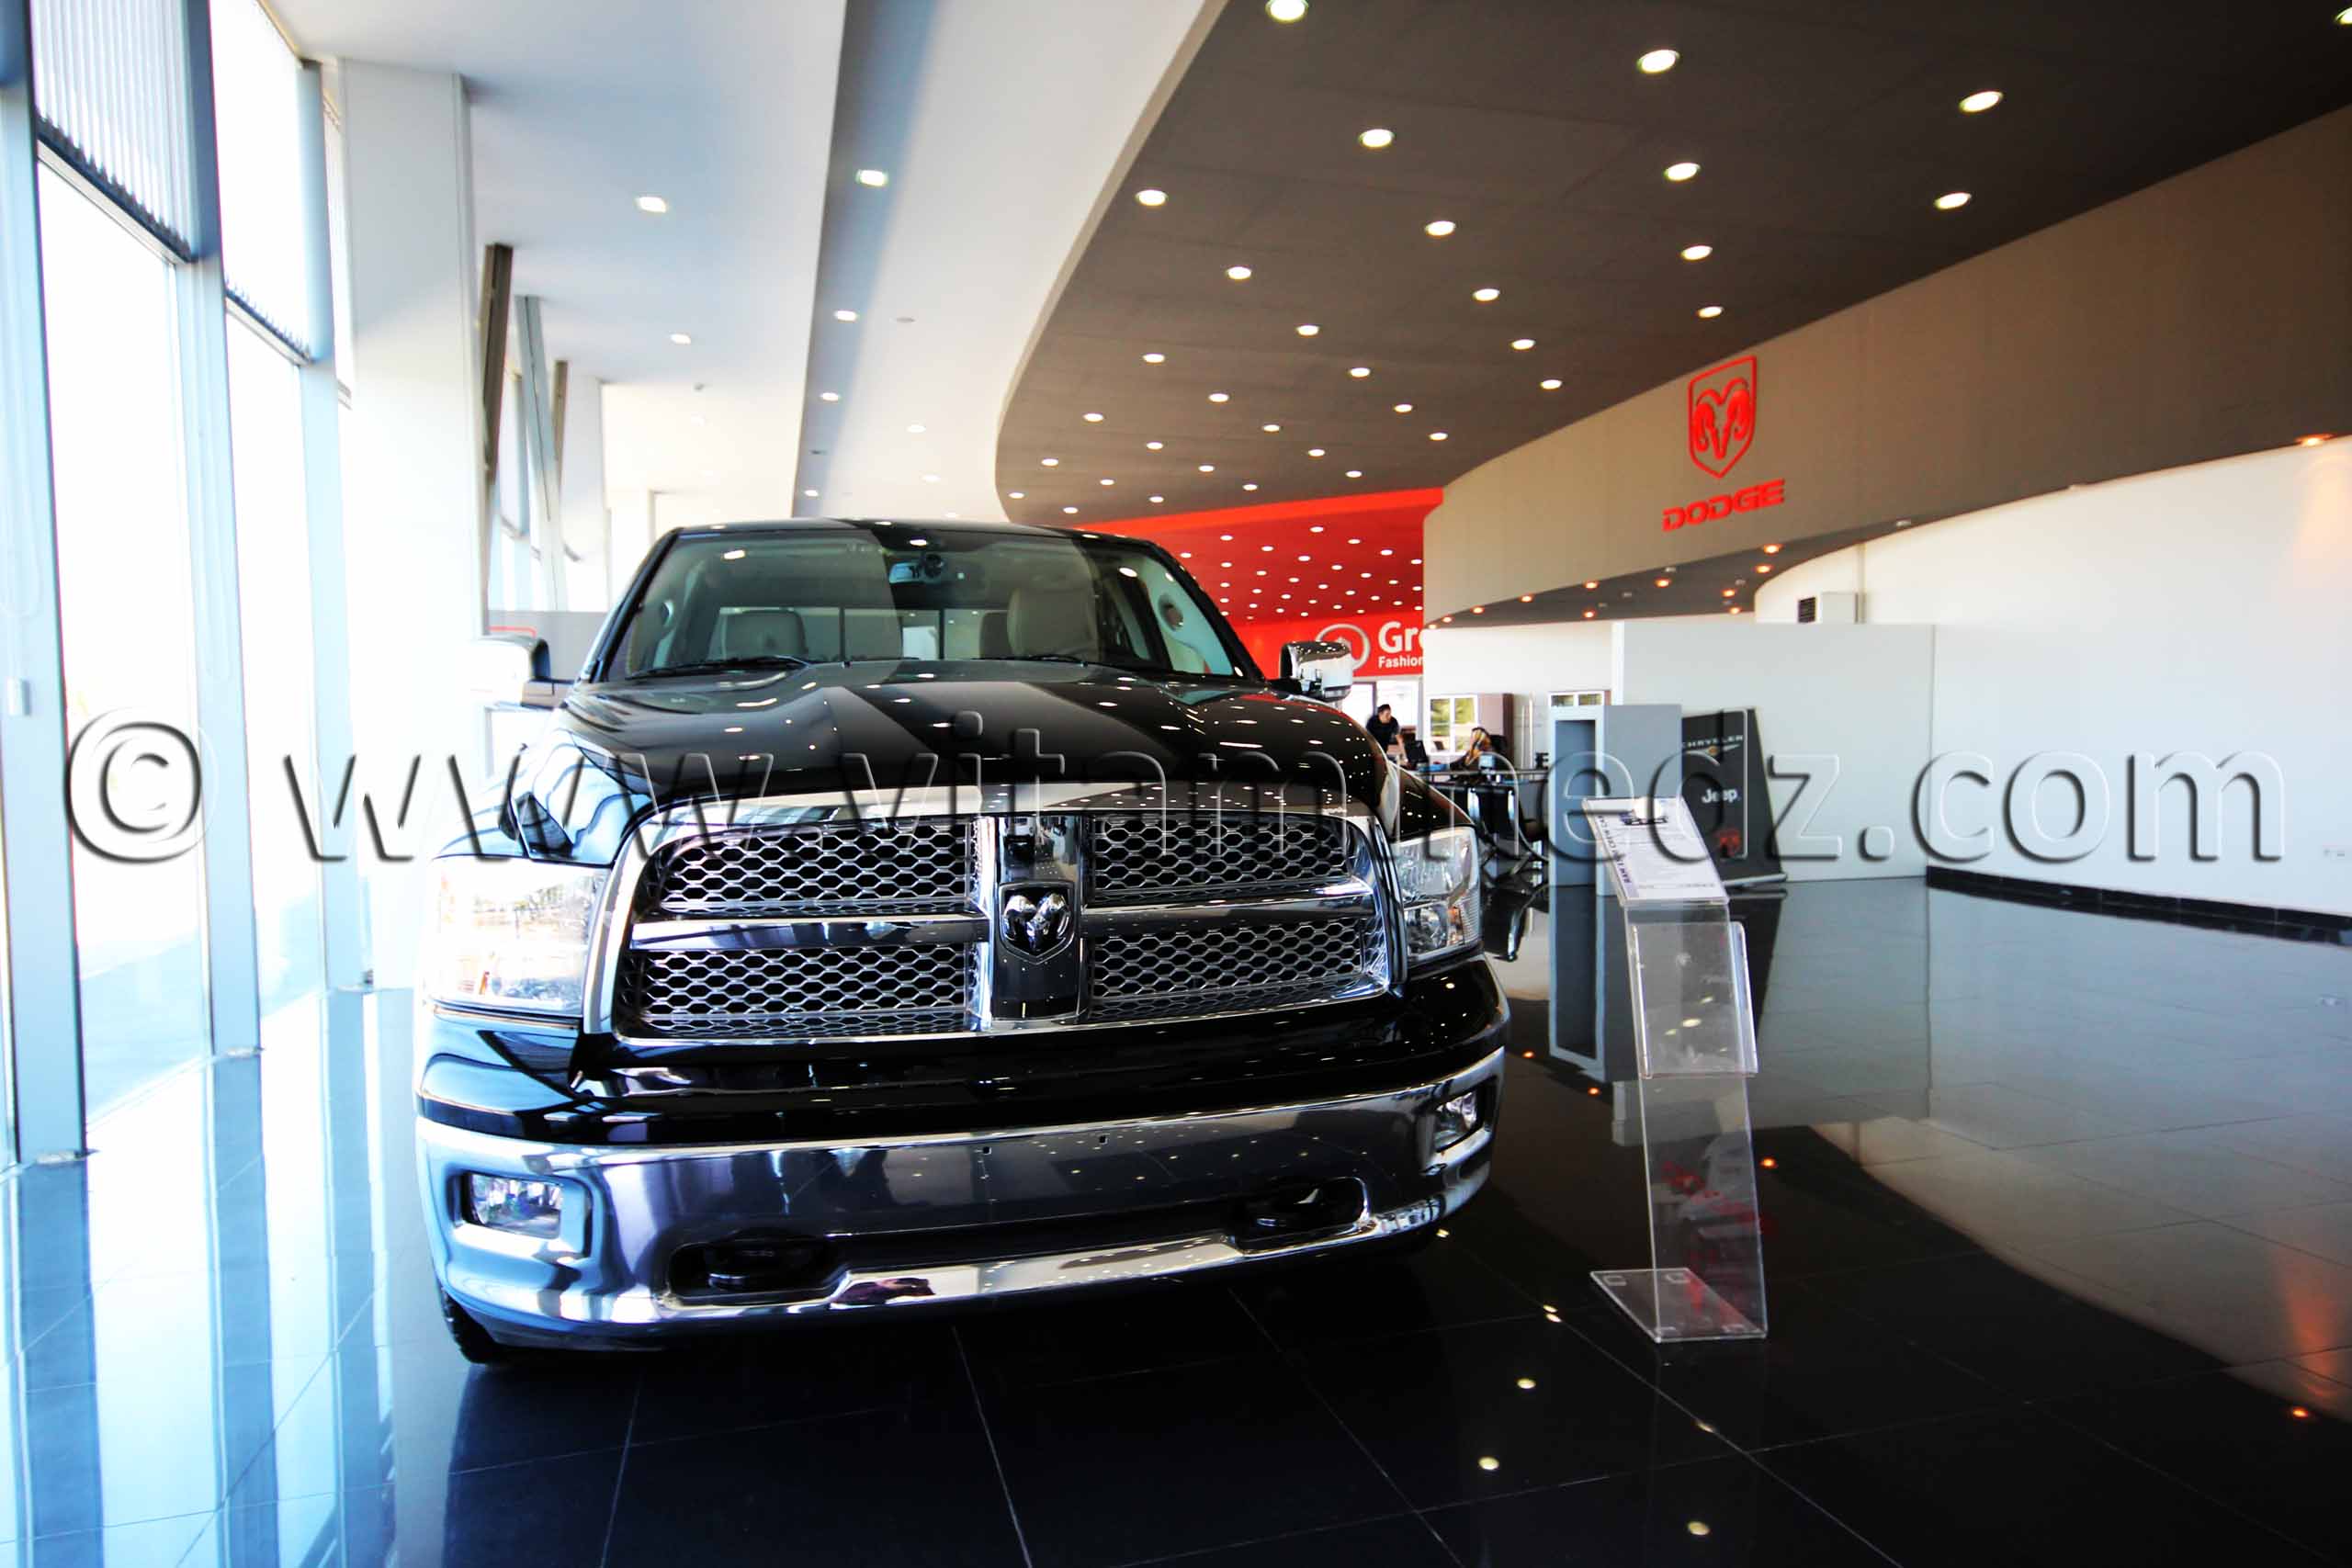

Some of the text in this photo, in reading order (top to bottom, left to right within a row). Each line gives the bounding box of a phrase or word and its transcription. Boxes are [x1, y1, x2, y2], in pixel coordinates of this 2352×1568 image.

[1663, 478, 1785, 532] DODGE
[1379, 620, 1423, 654] Gr
[1701, 788, 1739, 804] Jeep
